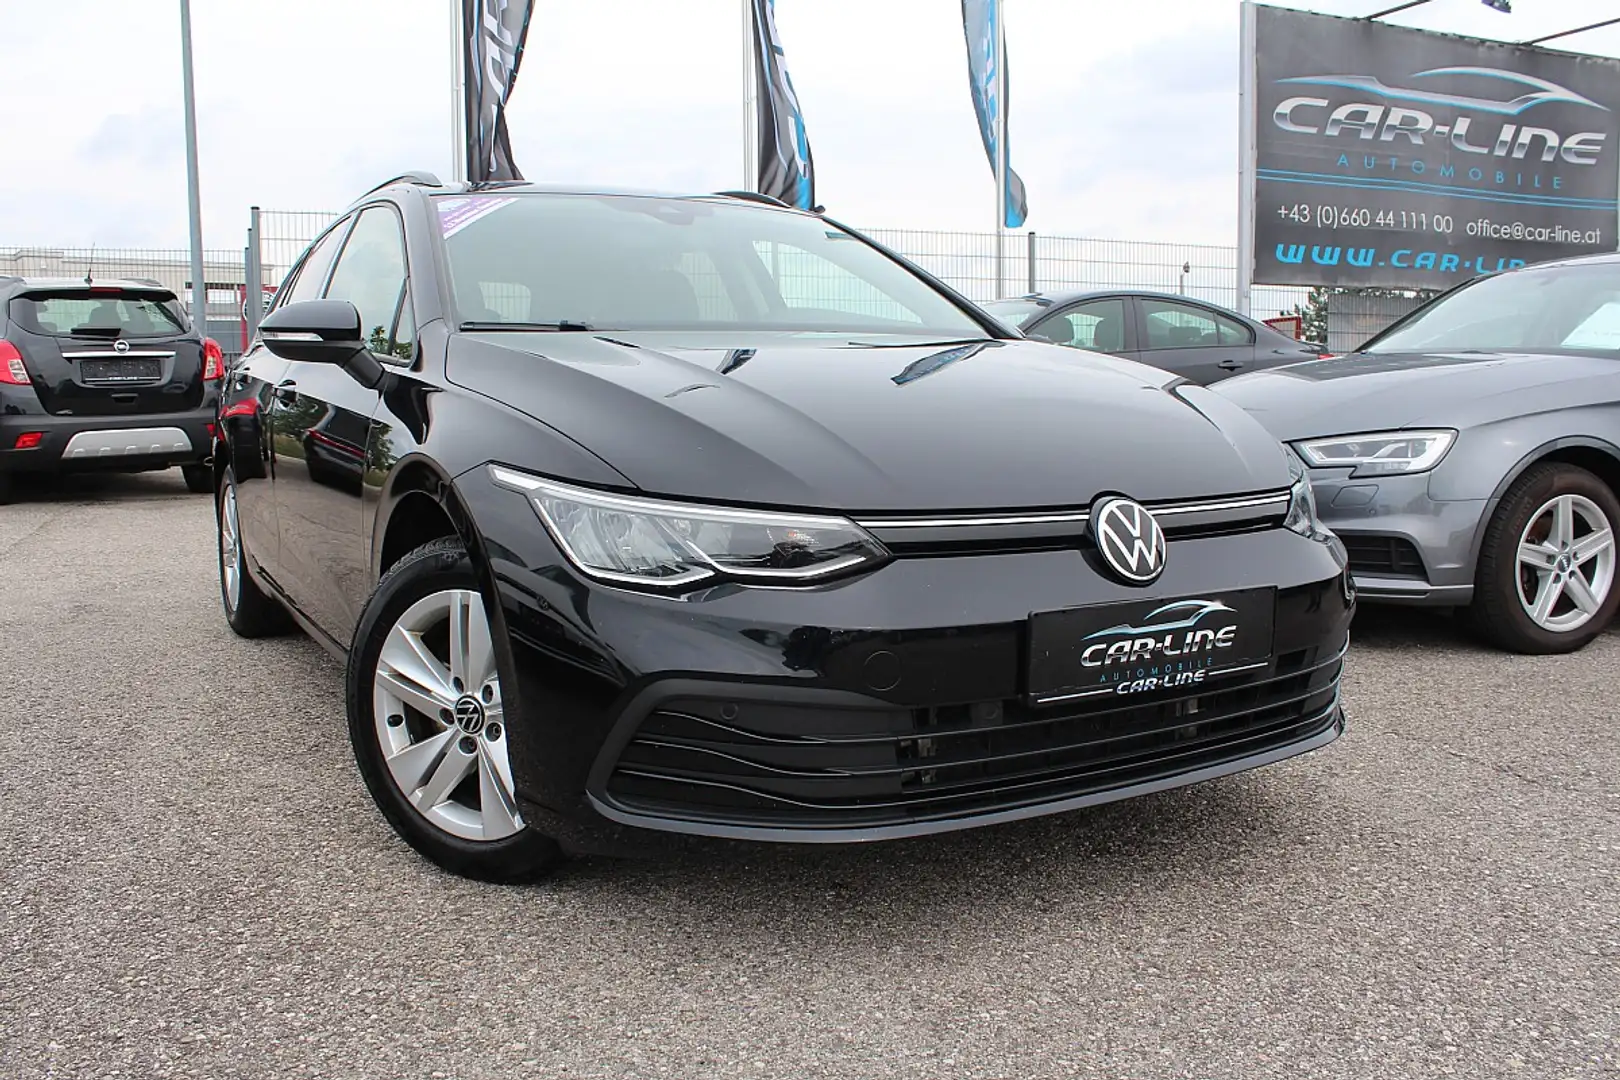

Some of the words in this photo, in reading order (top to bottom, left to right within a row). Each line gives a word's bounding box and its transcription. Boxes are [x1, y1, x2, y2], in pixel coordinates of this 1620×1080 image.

[1273, 97, 1607, 166] CAR-LINE
[1337, 153, 1563, 189] AUTOMOBILE
[1277, 204, 1311, 223] +43
[1317, 205, 1370, 229] (0)660
[1375, 210, 1395, 228] 44
[1401, 211, 1427, 230] 111
[1433, 214, 1454, 233] 00
[1466, 218, 1601, 245] office@car-line.at
[1081, 625, 1237, 667] CAR-LINE
[1100, 657, 1212, 683] AUTOMOBILE
[1116, 669, 1206, 695] CAR-LINE
